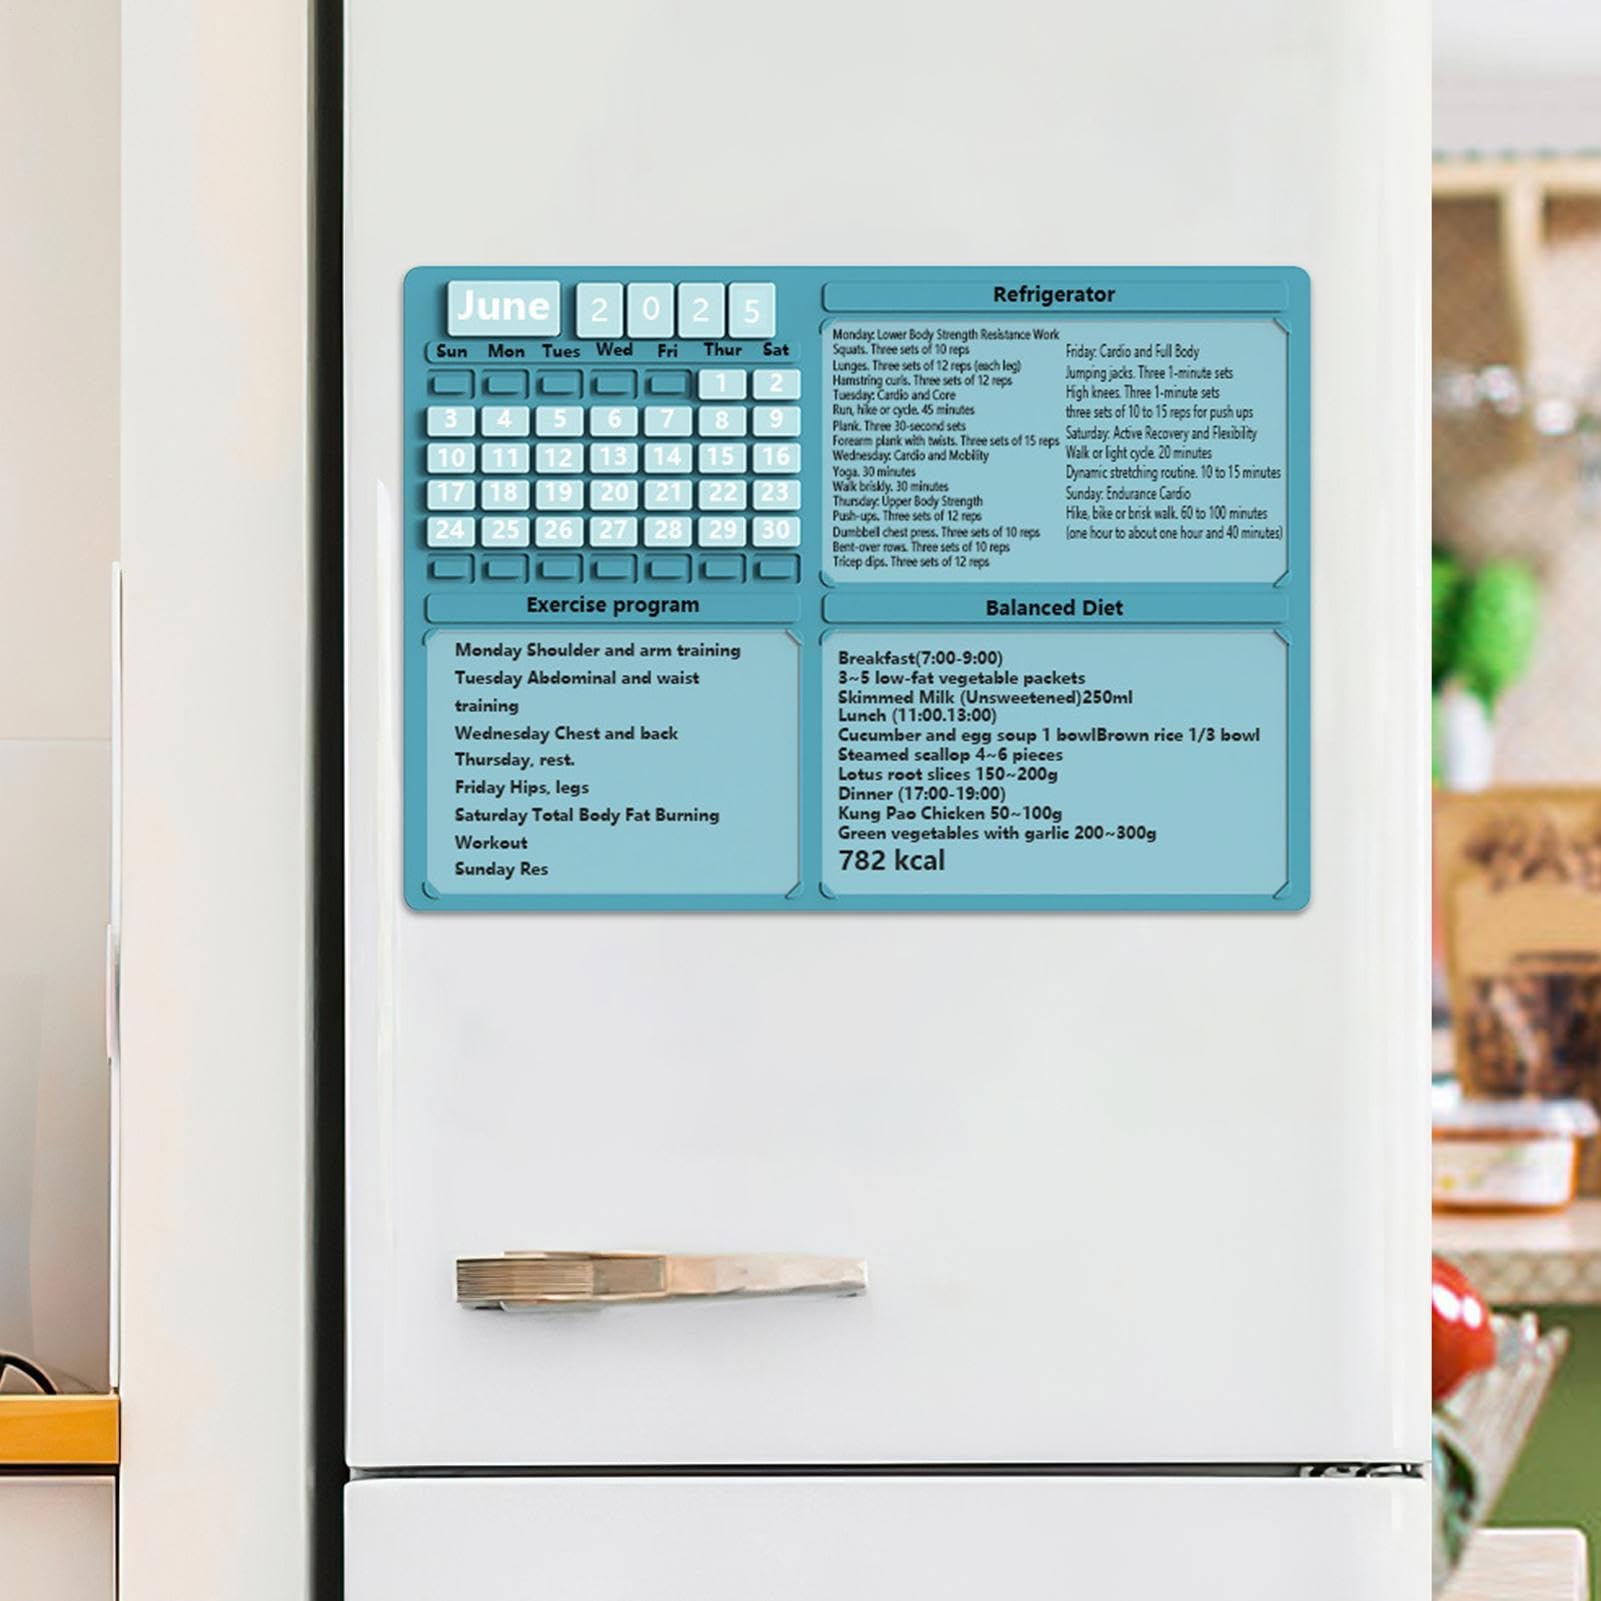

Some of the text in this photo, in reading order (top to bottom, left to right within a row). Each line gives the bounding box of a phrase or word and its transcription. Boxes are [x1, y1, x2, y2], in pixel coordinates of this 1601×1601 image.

[994, 285, 1116, 306] Refrigerator
[458, 290, 550, 320] June
[833, 328, 1060, 344] Monday: Lower Body Strength Resistance Work
[437, 341, 789, 358] Sun Mon Tues Wed Fri Thur Sat
[833, 343, 970, 358] Squats. Three sets of 10 reps
[1066, 343, 1200, 361] Friday: Cardio and Full Body
[1065, 364, 1234, 382] Jumping jacks. Three 1-minute sets
[716, 374, 783, 392] 1 2
[833, 388, 956, 404] Tuesday: Cardio and Core
[833, 420, 966, 432] Plank. Three 30-second sets
[1066, 425, 1258, 443] Saturday: Active Recovery and Flexibility
[439, 446, 790, 467] 10 11 12 13 14 15 16
[832, 449, 990, 464] Wednesday: Cardio and Mobility
[832, 465, 916, 481] Yoga. 30 minutes
[438, 483, 788, 502] 17 18 19 20 21 22 23
[832, 480, 949, 495] Walk briskly. 30 minutes
[1066, 485, 1191, 503] Sunday: Endurance Cardio
[833, 495, 983, 510] Thursday: Upper Body Strength
[527, 595, 699, 616] Exercise program
[986, 598, 1123, 616] Balanced Diet
[456, 642, 741, 661] Monday Shoulder and arm training
[454, 670, 700, 689] Tuesday Abdominal and waist
[875, 670, 934, 684] low-fat
[938, 670, 1019, 688] vegetable
[1024, 670, 1086, 687] packets
[838, 690, 914, 704] Skimmed
[919, 690, 955, 704] Milk
[454, 698, 519, 716] training
[839, 708, 886, 722] Lunch
[454, 726, 678, 745] Wednesday Chest and back
[838, 727, 922, 742] Cucumber
[926, 727, 956, 741] and
[961, 732, 992, 745] egg
[997, 732, 1037, 745] soup
[1042, 728, 1049, 741] 1
[1154, 732, 1183, 742] rice
[1189, 727, 1215, 743] 1/3
[1221, 727, 1260, 741] bowl
[454, 752, 575, 771] Thursday, rest.
[838, 747, 909, 761] Steamed
[914, 747, 970, 764] scallop
[1013, 752, 1063, 764] pieces
[839, 767, 883, 781] Lotus
[888, 768, 923, 781] root
[927, 767, 971, 781] slices
[456, 780, 589, 798] Friday Hips, legs
[839, 786, 893, 800] Dinner
[455, 807, 720, 826] Saturday Total Body Fat Burning
[839, 806, 881, 823] Kung
[886, 806, 916, 820] Pao
[921, 806, 985, 820] Chicken
[455, 835, 528, 849] Workout
[838, 825, 886, 840] Green
[891, 825, 979, 843] vegetables
[984, 825, 1019, 839] with
[1024, 825, 1069, 843] garlic
[839, 848, 944, 871] 782 kcal
[455, 861, 548, 880] Sunday Res
